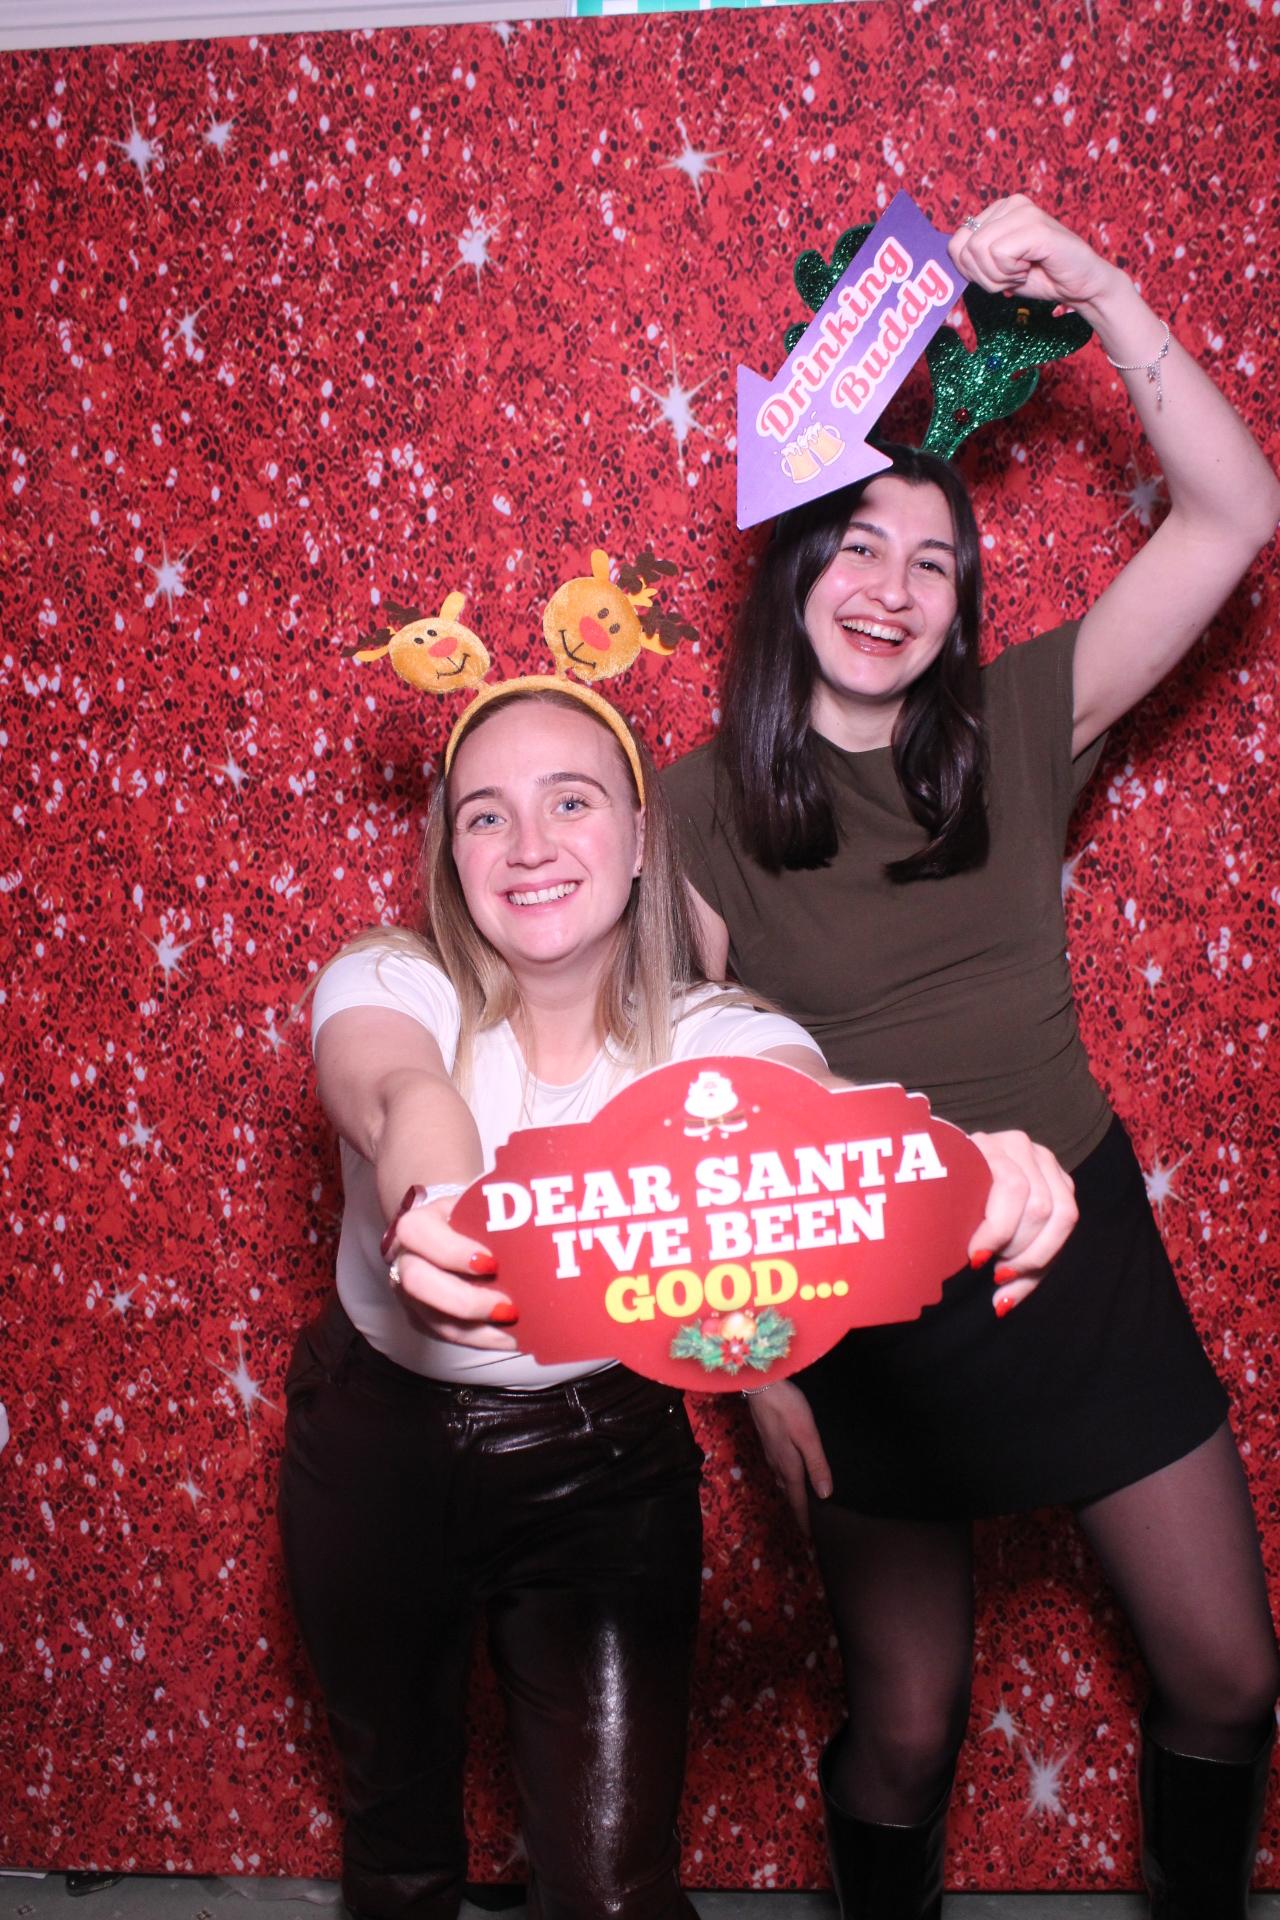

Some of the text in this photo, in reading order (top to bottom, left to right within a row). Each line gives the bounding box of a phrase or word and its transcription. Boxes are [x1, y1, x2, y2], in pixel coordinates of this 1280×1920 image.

[758, 239, 911, 440] Drinking
[833, 262, 951, 411] Buddy
[483, 1132, 947, 1232] DEAR SANTA
[552, 1193, 887, 1279] I'VE BEEN
[605, 1258, 848, 1324] GOOD...
